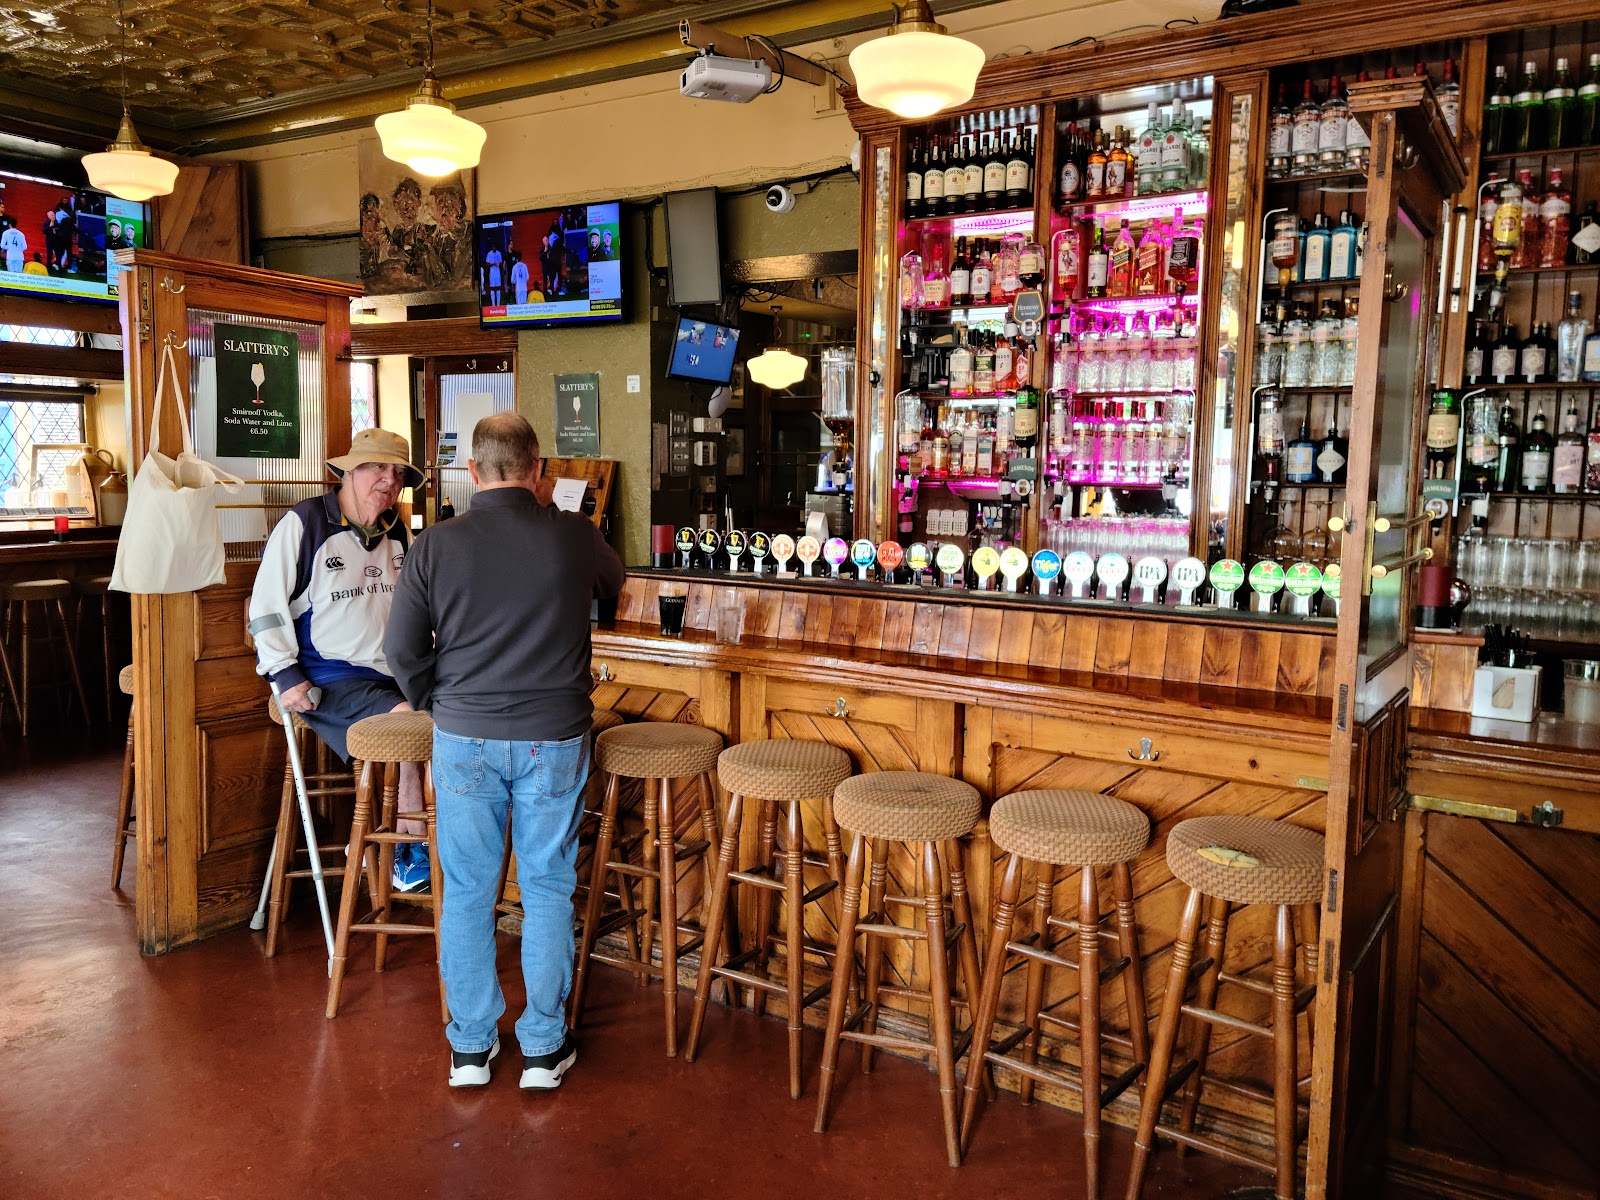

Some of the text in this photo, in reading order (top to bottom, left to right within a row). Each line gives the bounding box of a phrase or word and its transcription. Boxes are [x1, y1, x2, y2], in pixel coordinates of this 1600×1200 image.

[518, 268, 524, 279] 4
[224, 340, 289, 356] SLATTERY'S
[559, 383, 594, 391] SLATTERY'S
[232, 408, 261, 416] Smirnoff
[1010, 465, 1035, 473] JAMESON
[1035, 558, 1060, 573] Tiger
[1066, 563, 1091, 573] Coors
[1100, 564, 1126, 574] Coors
[1210, 574, 1244, 582] Heineken
[1251, 576, 1284, 584] Heineken
[1286, 578, 1322, 586] Heineken
[331, 586, 364, 601] Bank
[367, 583, 378, 593] of
